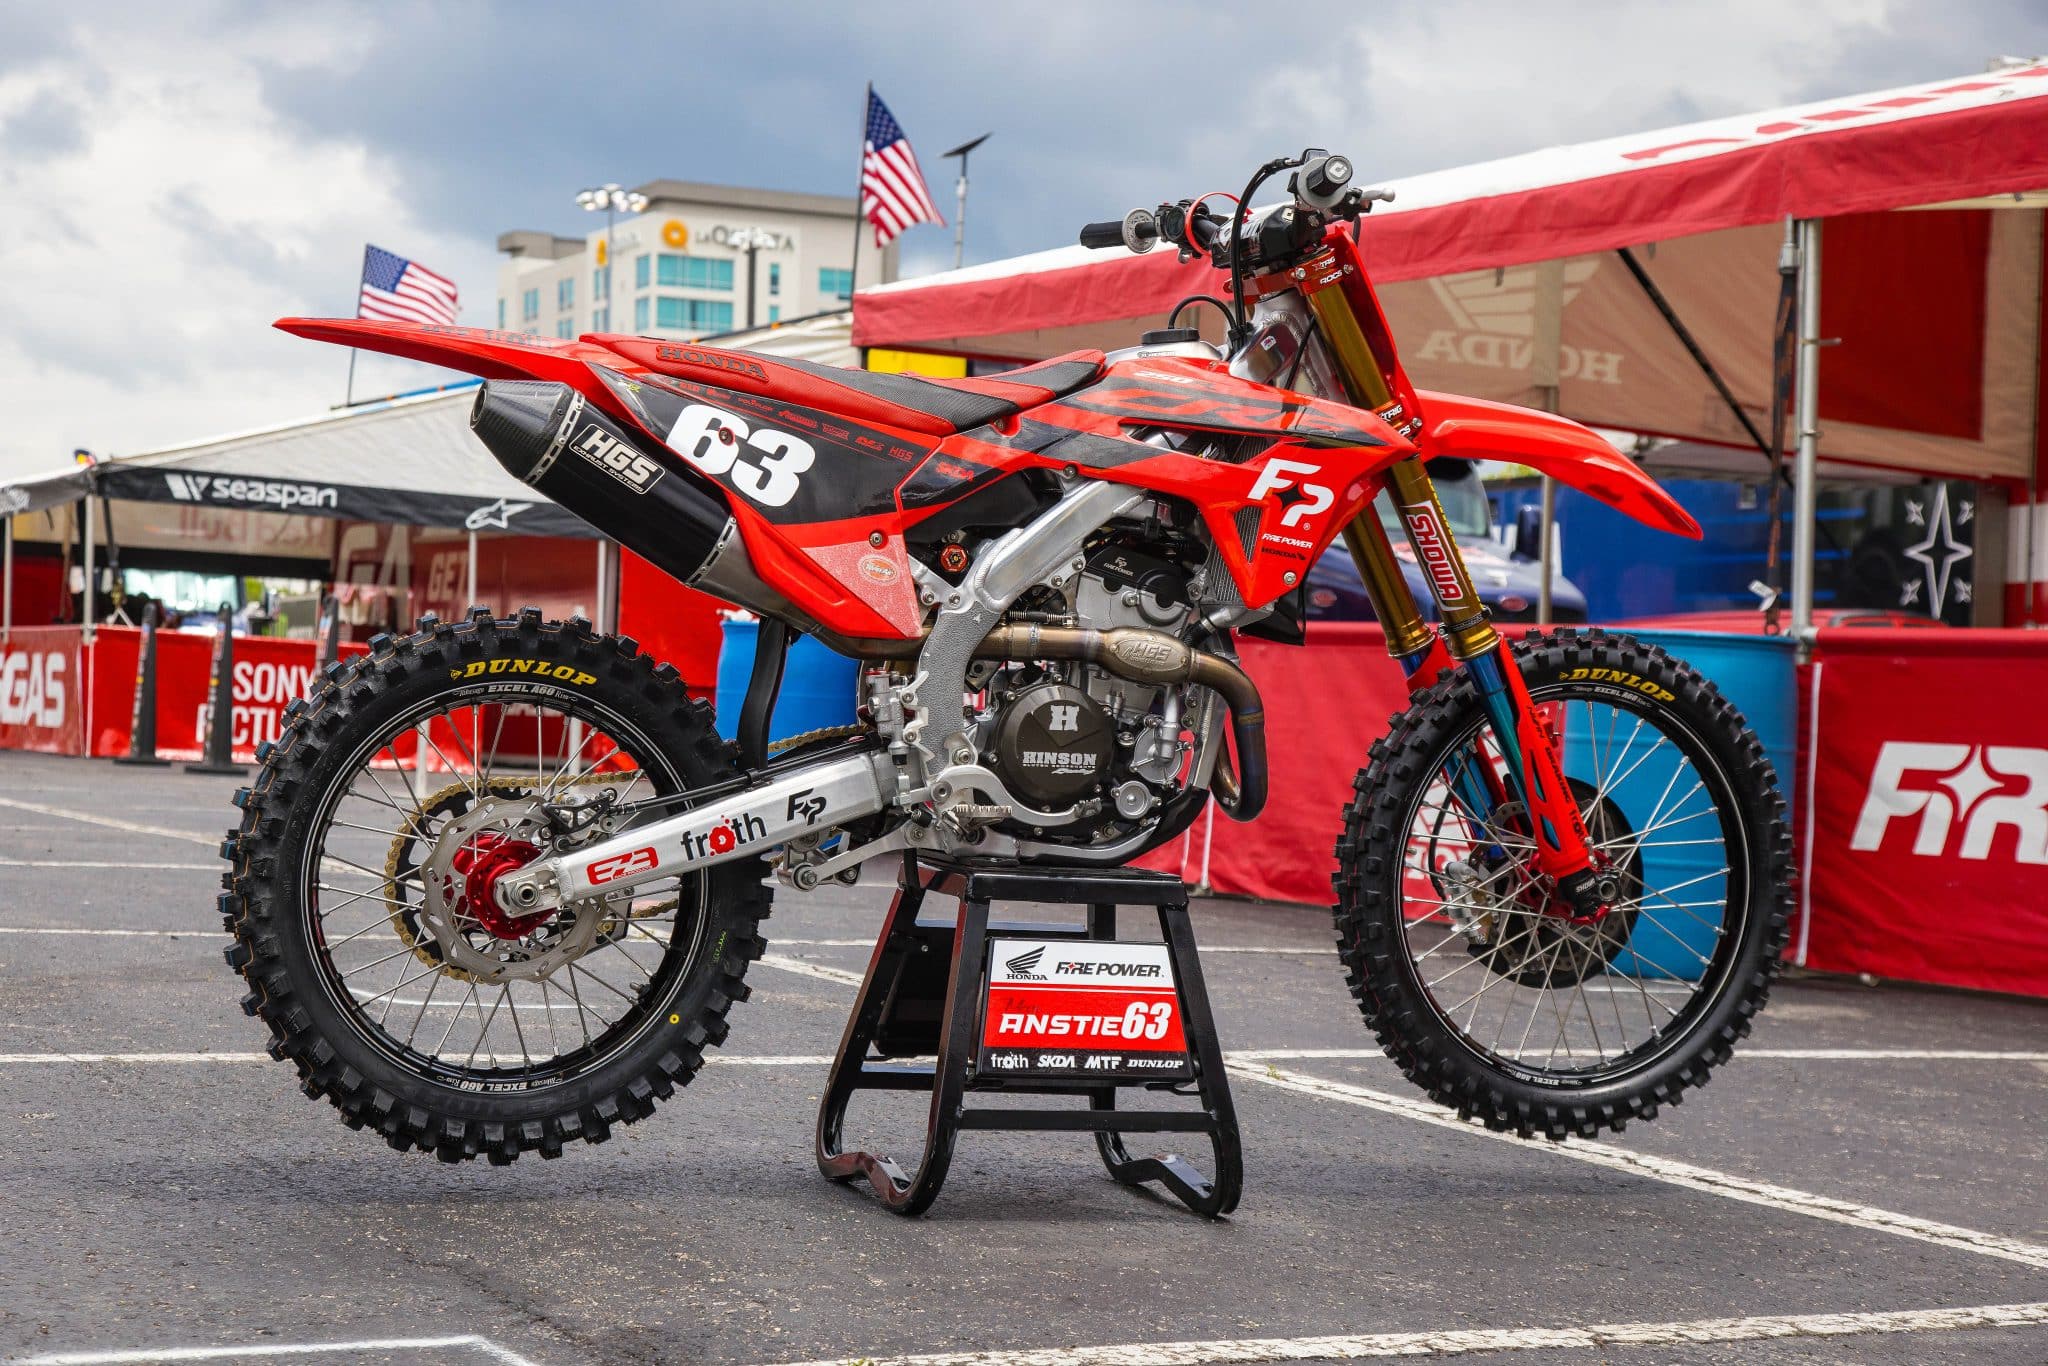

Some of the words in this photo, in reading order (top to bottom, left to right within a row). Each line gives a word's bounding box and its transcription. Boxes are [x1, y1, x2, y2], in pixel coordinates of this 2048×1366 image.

[661, 347, 766, 379] HONDA
[573, 445, 608, 468] EXHAUST
[580, 429, 658, 485] HGS
[666, 403, 815, 507] 63
[212, 477, 338, 509] seaspan
[1247, 457, 1335, 527] FP
[1262, 533, 1281, 544] FIRE
[1281, 537, 1314, 549] POWER
[1406, 513, 1464, 600] SHOWA
[232, 659, 316, 705] SONY
[464, 658, 598, 686] DUNLOP
[1568, 667, 1676, 702] DUNLOP
[488, 684, 529, 694] EXCEL
[530, 685, 555, 696] A60
[1594, 686, 1621, 697] EXCEL
[1049, 704, 1079, 732] H
[1022, 751, 1097, 766] HINSON
[786, 787, 828, 827] FP
[1850, 741, 2048, 865] FIR
[680, 811, 768, 862] froth
[1575, 877, 1597, 894] SHOWA
[1007, 973, 1049, 982] HONDA
[1055, 961, 1096, 976] FIRE
[1097, 962, 1162, 979] POWER
[991, 1052, 1029, 1069] froth
[1037, 1055, 1076, 1069] SKDA
[1084, 1055, 1122, 1070] MTF
[1126, 1059, 1184, 1069] DUNLOP
[459, 1080, 485, 1092] A60
[486, 1081, 528, 1092] EXCEL
